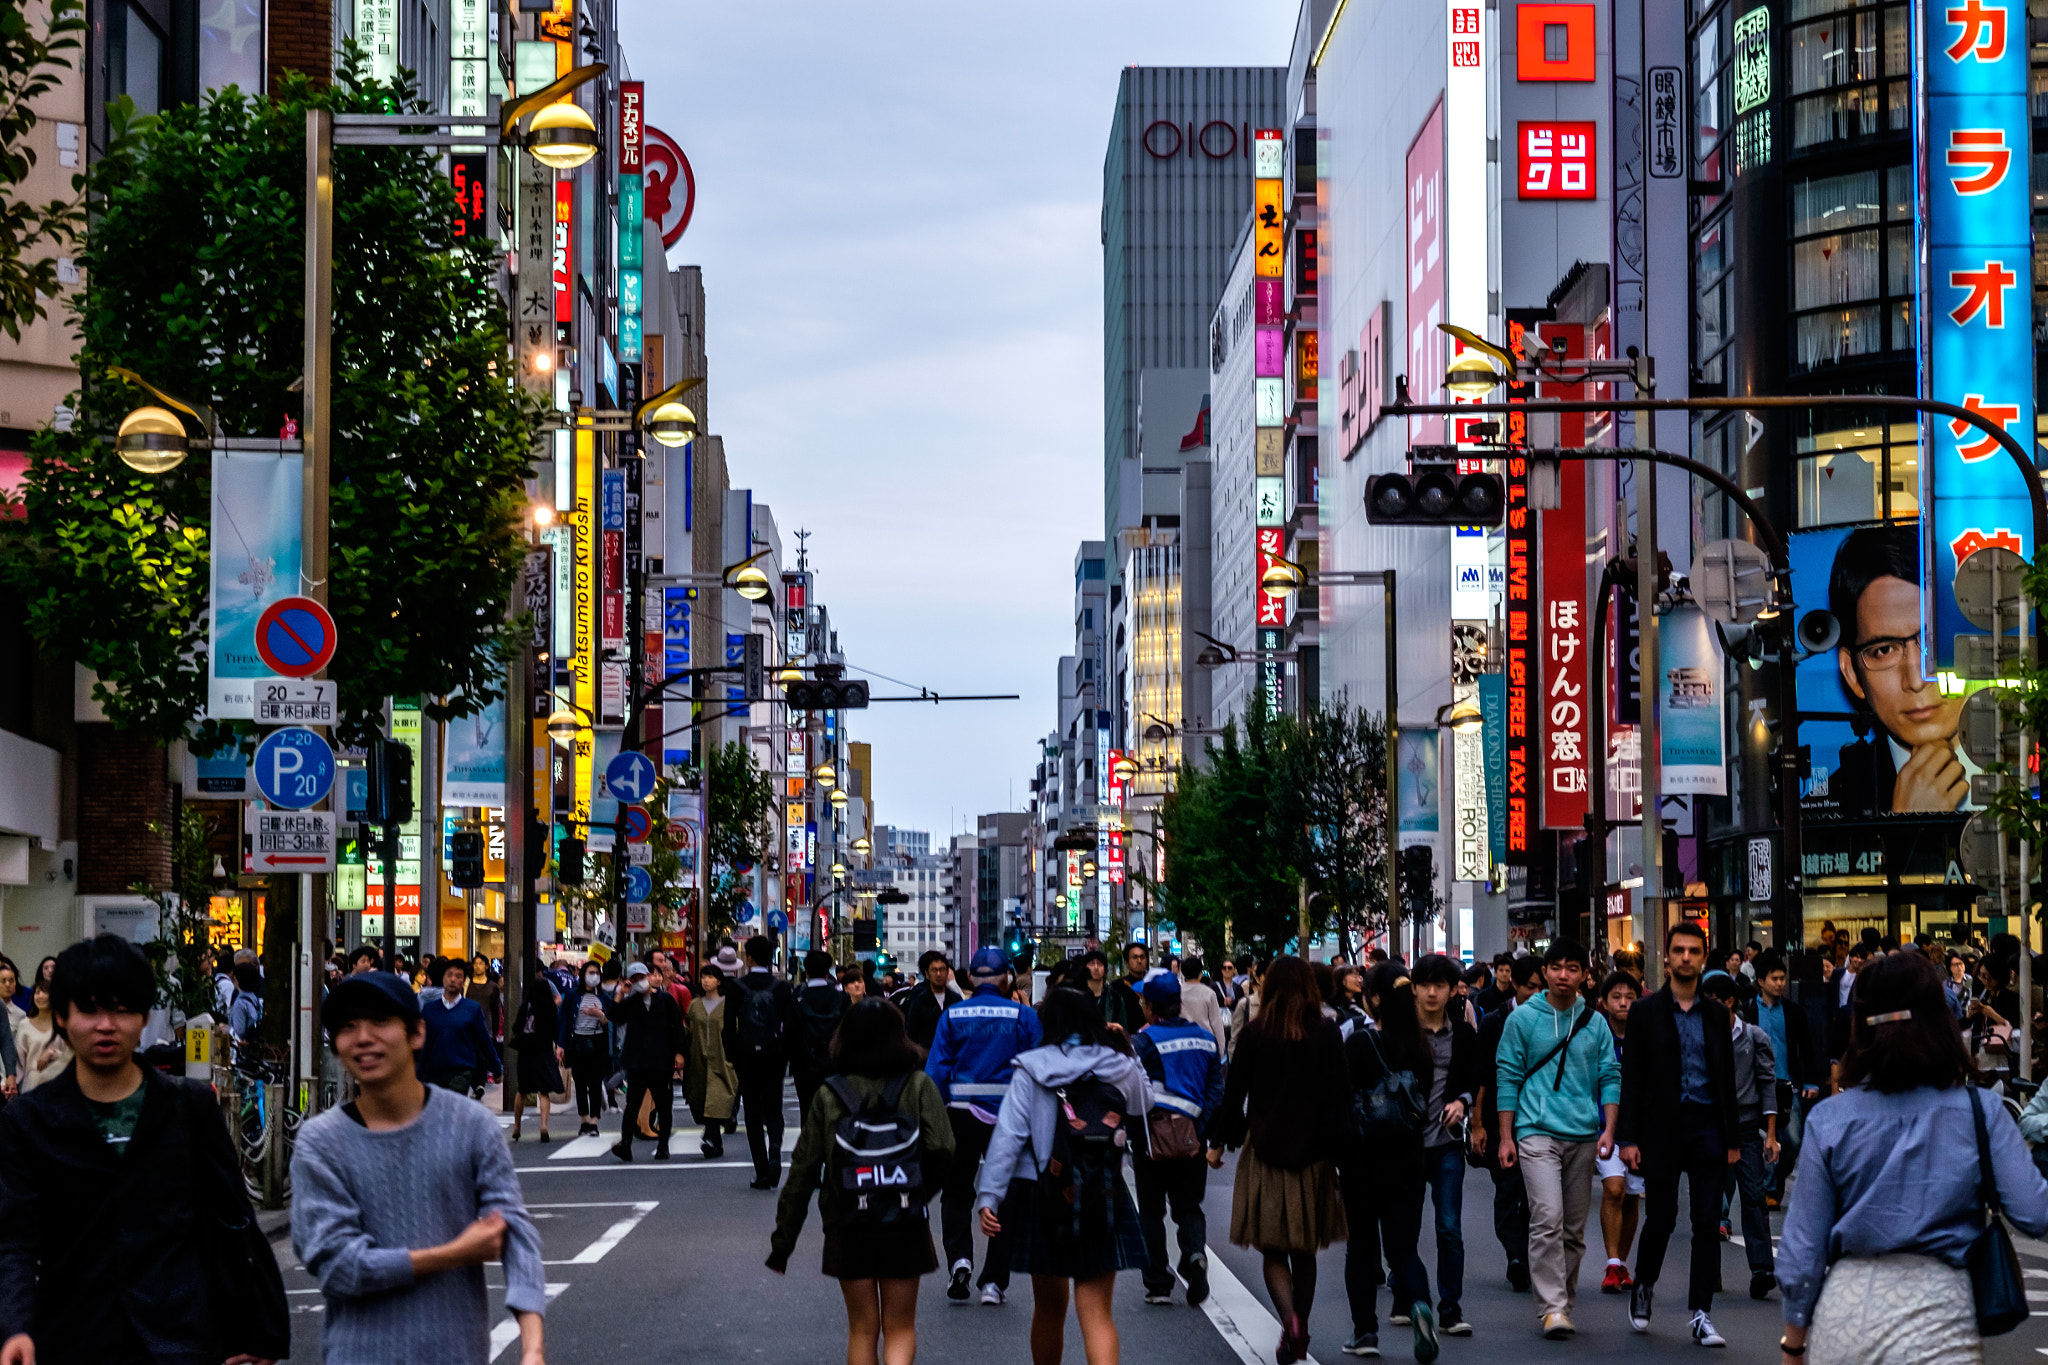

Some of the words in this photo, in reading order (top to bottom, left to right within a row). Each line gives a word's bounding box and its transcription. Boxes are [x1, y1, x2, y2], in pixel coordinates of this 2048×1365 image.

[623, 92, 639, 165] アカネビル
[1655, 72, 1677, 173] 眼鏡市場
[473, 181, 484, 221] disk
[224, 653, 261, 664] TIFFAN
[260, 704, 331, 719] 日曜・休日は終日
[267, 685, 287, 701] 20
[314, 686, 324, 702] 7
[279, 733, 312, 746] 7-20
[1485, 693, 1502, 770] DIAMOND
[274, 747, 304, 796] P
[295, 774, 317, 797] 20
[1510, 745, 1526, 793] TAX
[1476, 765, 1487, 833] PANERAI
[1489, 774, 1506, 846] SHIRAISHI
[260, 816, 330, 832] 日曜・休日を除く
[1462, 808, 1477, 879] ROLEX
[1509, 797, 1526, 852] FREE
[192, 1031, 205, 1041] 20
[856, 1164, 909, 1188] FILA
